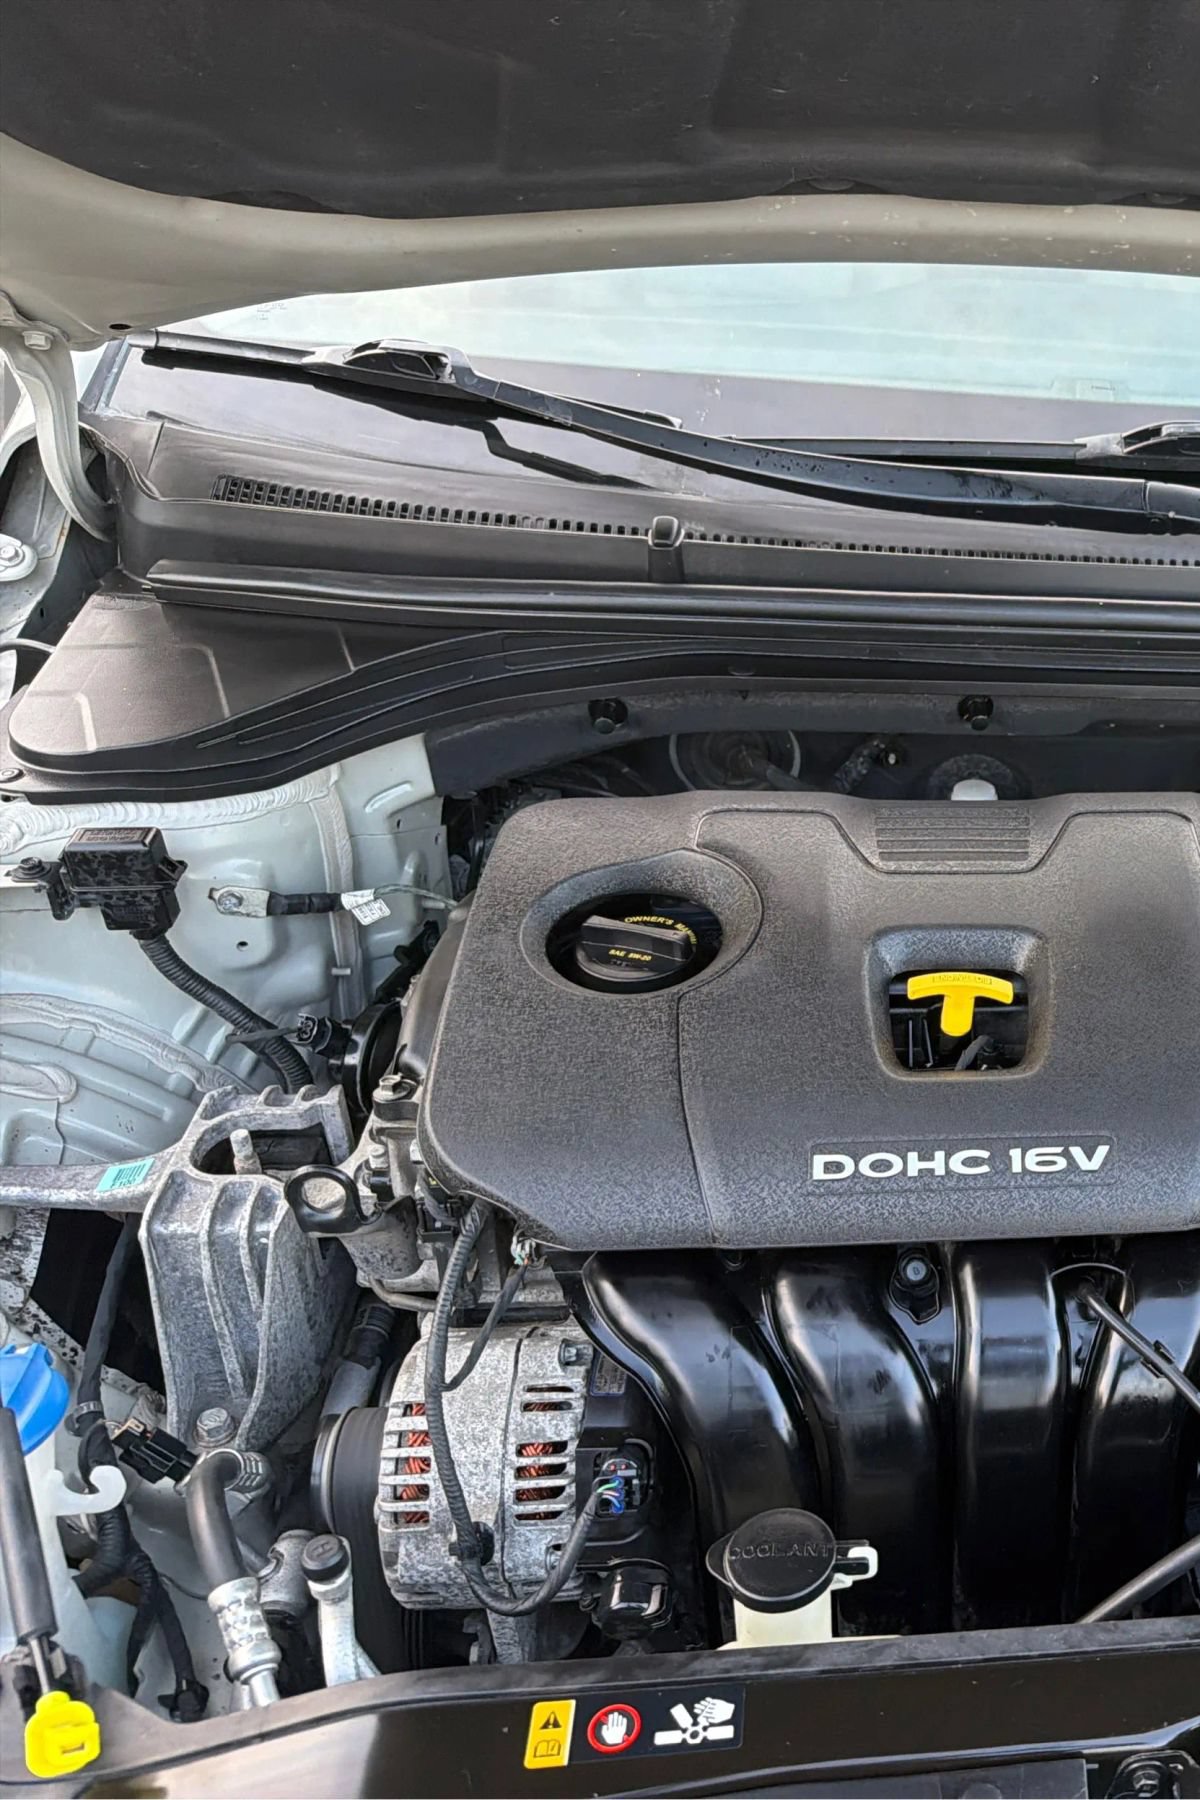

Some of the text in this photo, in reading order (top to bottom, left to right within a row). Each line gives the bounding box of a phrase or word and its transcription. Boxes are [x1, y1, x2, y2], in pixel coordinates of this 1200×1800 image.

[624, 915, 675, 926] OWNER'S
[812, 1144, 1110, 1181] DOHC 16V
[729, 1542, 834, 1561] COOLANT
